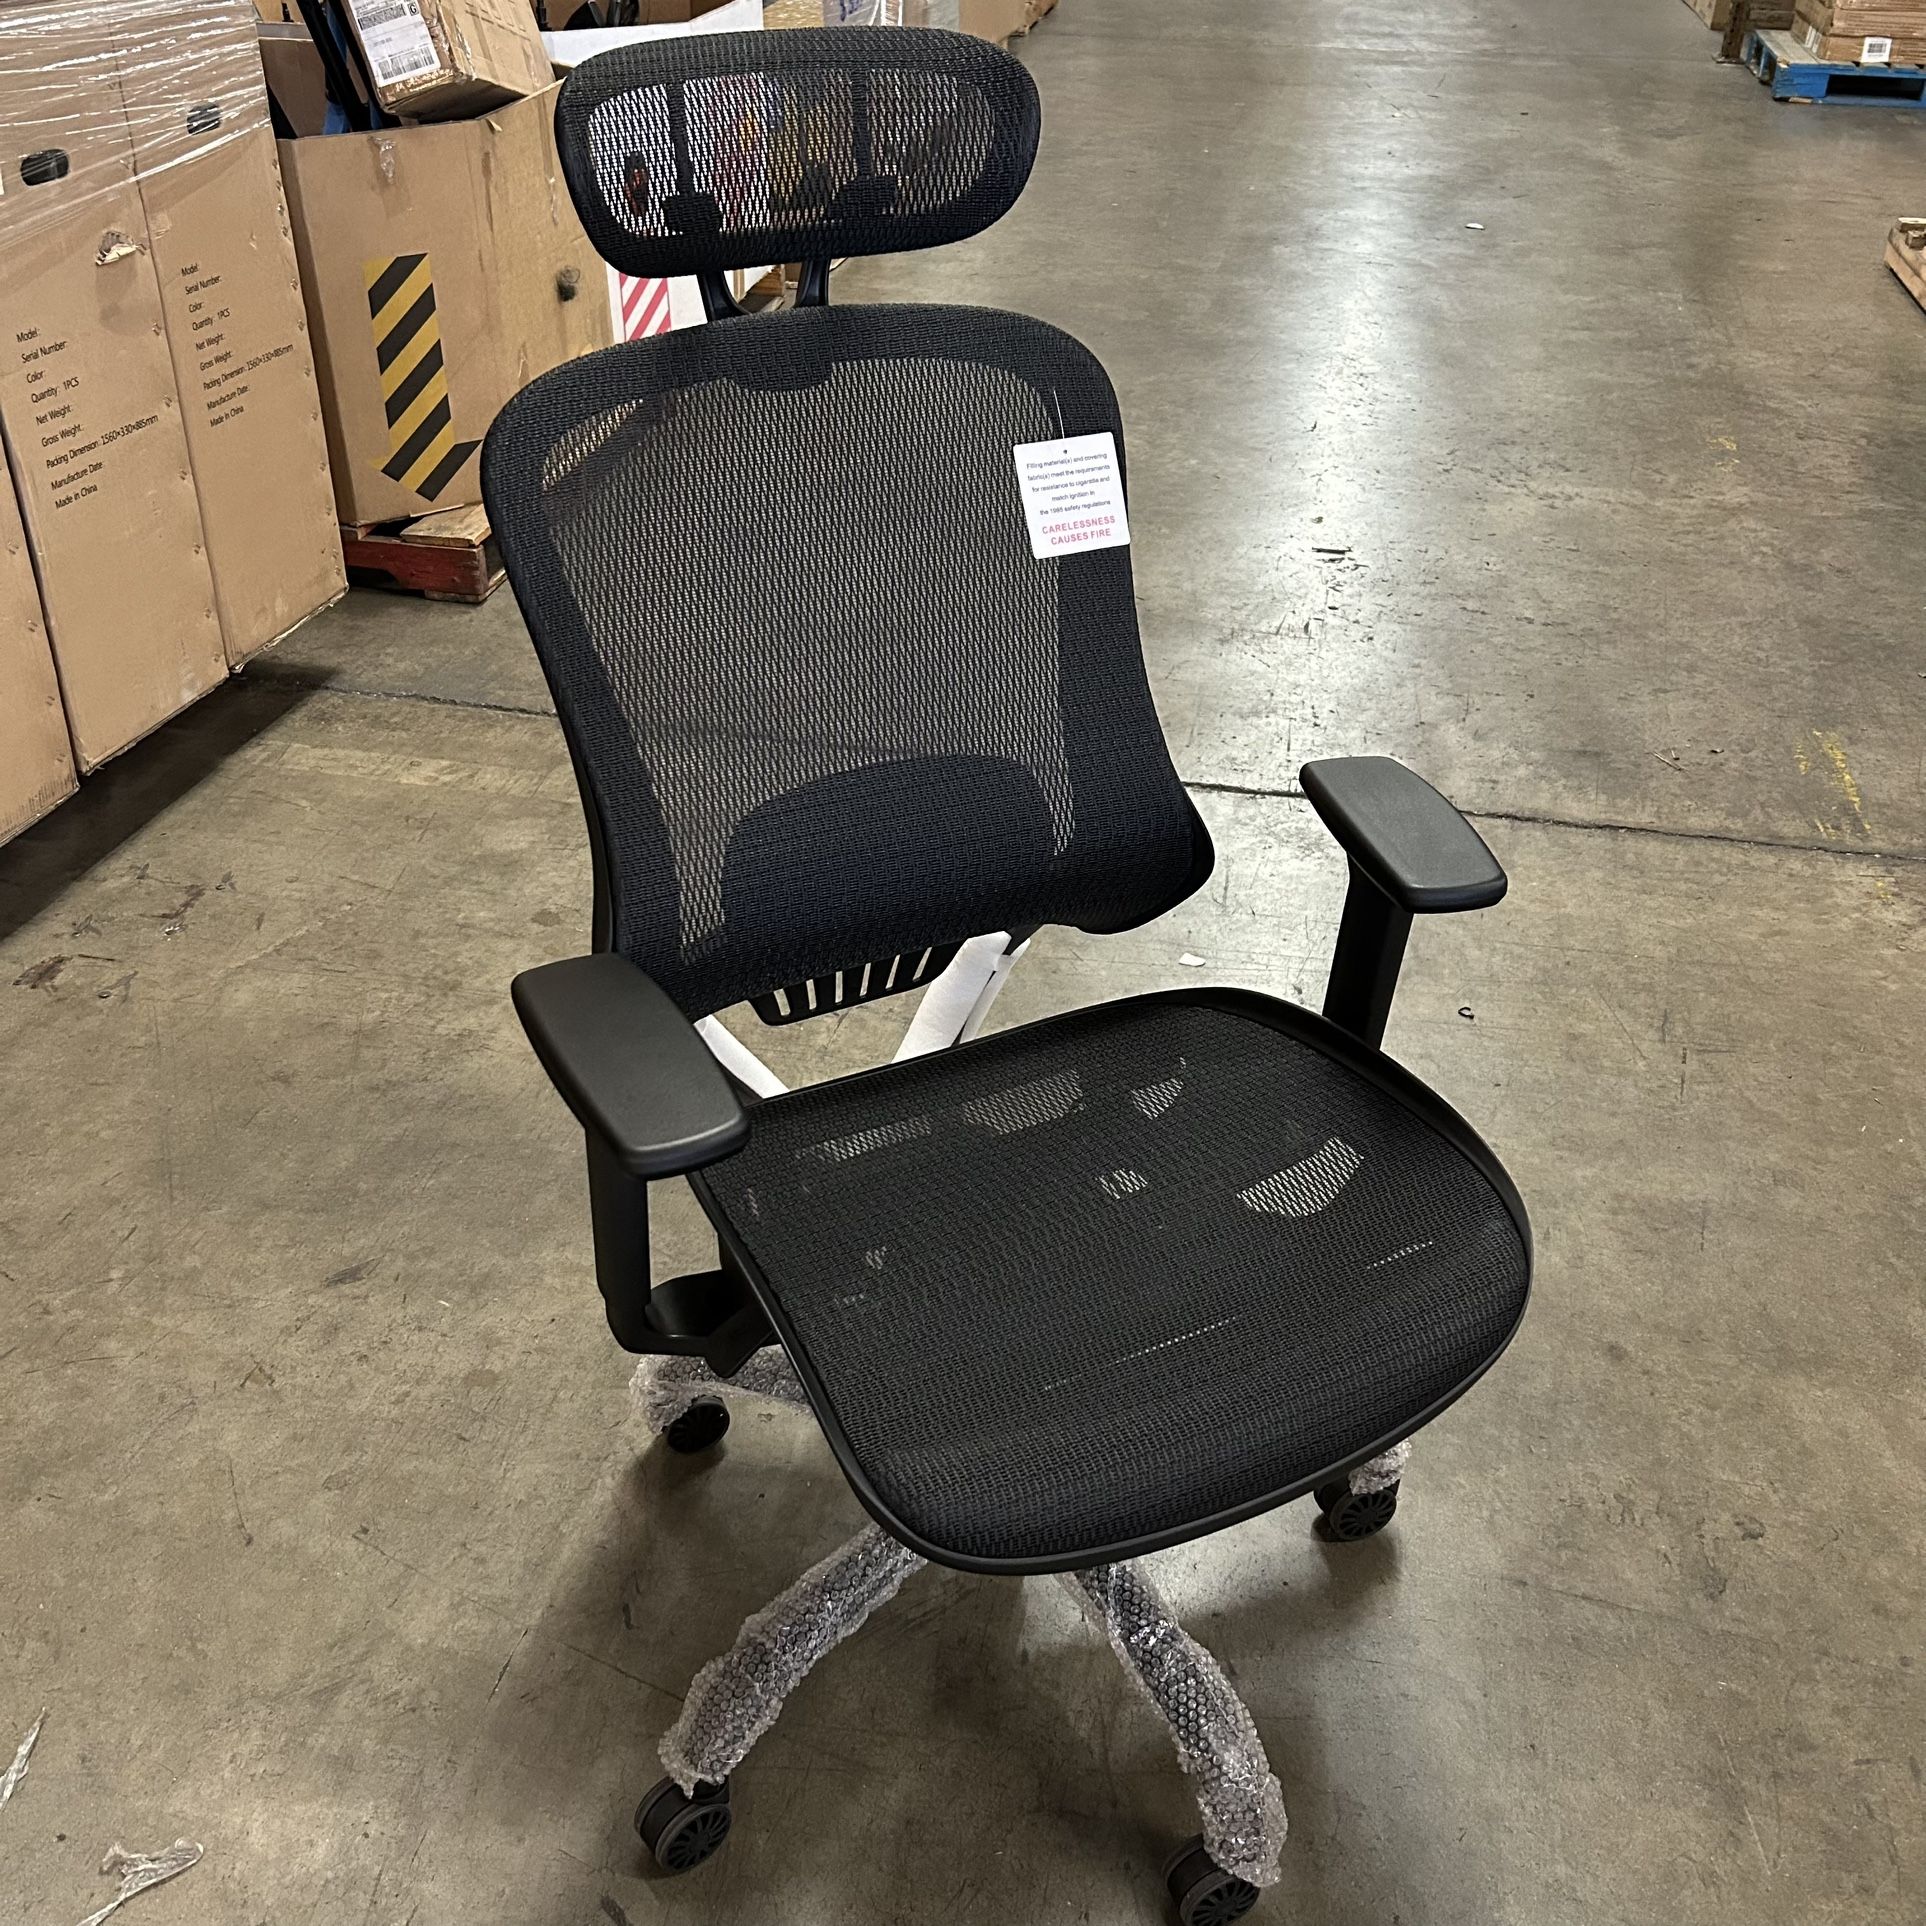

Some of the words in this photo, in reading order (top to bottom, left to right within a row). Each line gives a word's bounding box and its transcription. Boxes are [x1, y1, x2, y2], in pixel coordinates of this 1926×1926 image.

[185, 281, 199, 295] Serial
[217, 307, 231, 320] 1PCS
[16, 327, 41, 343] Model:
[195, 340, 206, 351] Net
[21, 348, 40, 363] Serial
[200, 359, 214, 371] Gross
[62, 376, 80, 391] 1PCS
[203, 377, 222, 391] Packing
[206, 390, 237, 411] Manufacture
[36, 413, 48, 426] Net
[209, 415, 225, 428] Made
[224, 411, 230, 420] in
[229, 405, 245, 417] China
[41, 434, 60, 448] Gross
[46, 454, 69, 469] Packing
[1043, 457, 1072, 467] material(s)
[1084, 453, 1107, 461] covering
[51, 468, 88, 490] Manufacture
[1027, 472, 1050, 481] fabric(s)
[1075, 464, 1110, 474] requirements
[1040, 482, 1069, 492] resistance
[1075, 478, 1099, 487] cigarette
[55, 495, 73, 509] Made
[74, 492, 80, 501] in
[80, 484, 98, 497] China
[1051, 493, 1069, 501] match
[1069, 490, 1089, 500] ignition
[1064, 503, 1080, 512] safety
[1081, 499, 1111, 509] regulations
[1042, 515, 1116, 535] CARELESSNESS
[1050, 531, 1089, 545] CAUSES
[1090, 527, 1112, 539] FIRE
